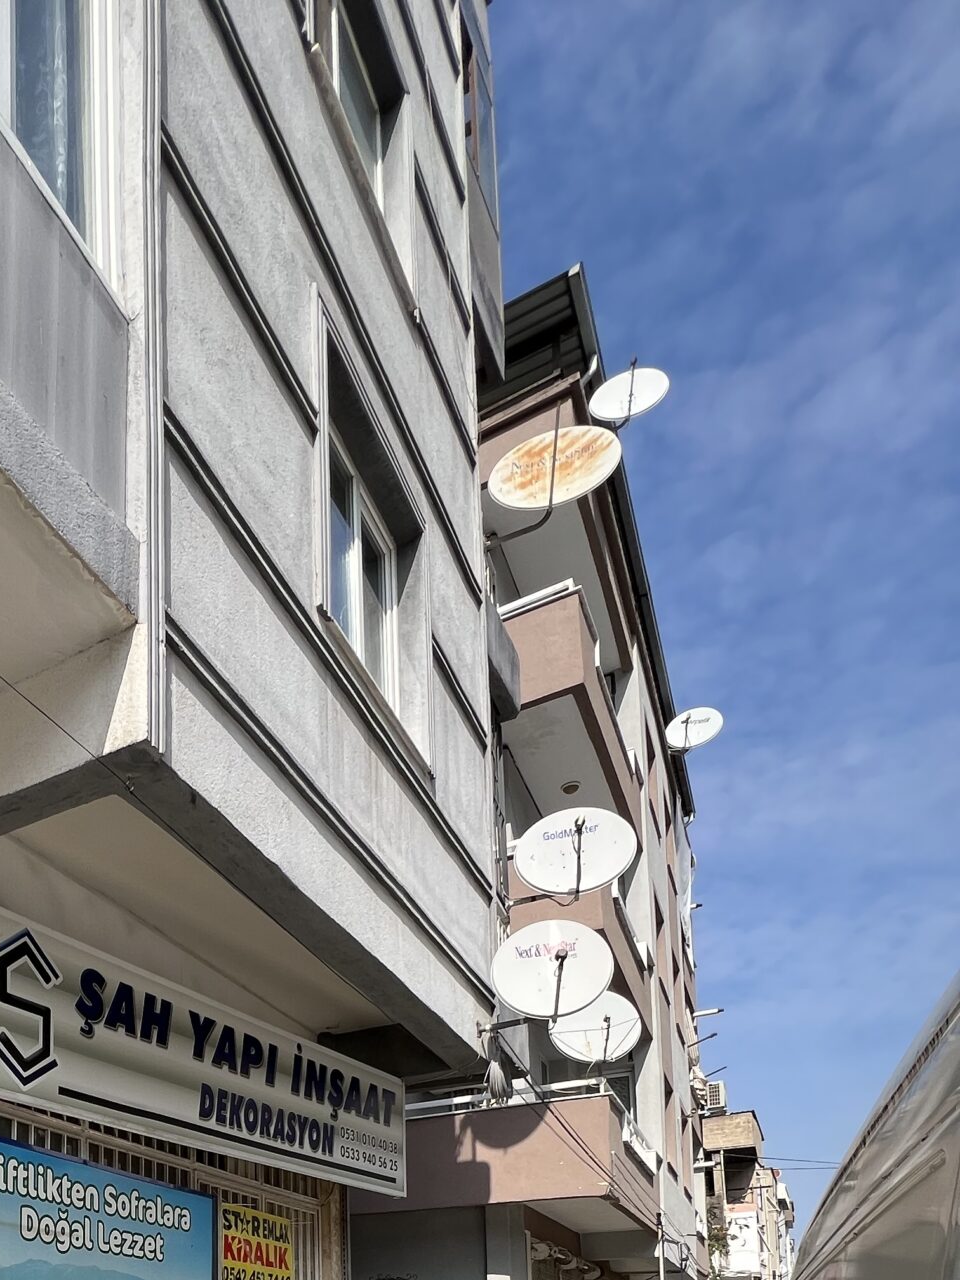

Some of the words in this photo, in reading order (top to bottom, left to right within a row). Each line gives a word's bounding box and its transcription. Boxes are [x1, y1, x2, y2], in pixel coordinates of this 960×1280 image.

[542, 825, 599, 841] GoldMter
[542, 940, 577, 957] NeStar
[74, 967, 174, 1050] ŞAH
[189, 1009, 279, 1087] YAPI
[290, 1042, 397, 1127] İNŞAAT
[199, 1082, 335, 1158] DEKORASYON
[340, 1126, 359, 1142] 0531
[362, 1133, 376, 1148] 010
[378, 1139, 387, 1151] 40
[389, 1141, 398, 1154] 38
[340, 1145, 360, 1162] 0533
[362, 1151, 376, 1166] 940
[379, 1156, 388, 1169] 56
[389, 1159, 398, 1172] 25
[103, 1184, 191, 1232] Sofralara
[19, 1204, 94, 1254] Doğal
[96, 1220, 165, 1262] Lezzet
[262, 1218, 290, 1245] EMLAK
